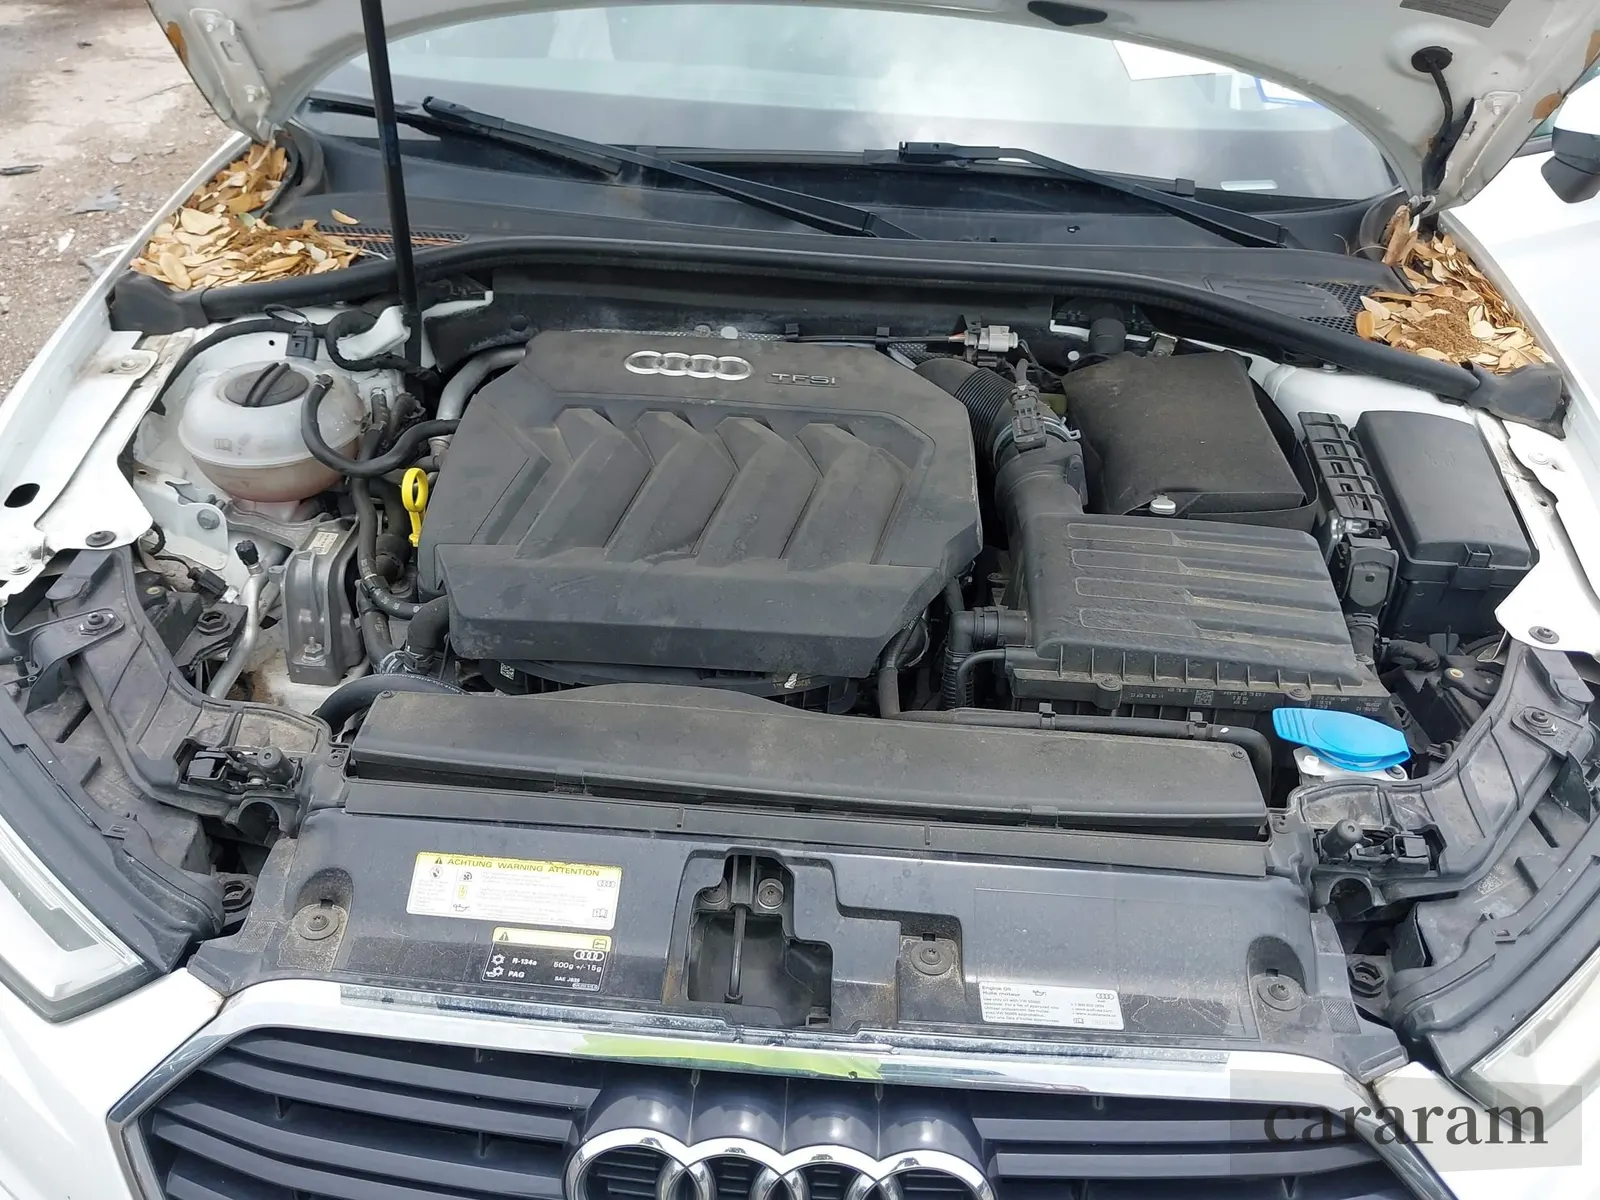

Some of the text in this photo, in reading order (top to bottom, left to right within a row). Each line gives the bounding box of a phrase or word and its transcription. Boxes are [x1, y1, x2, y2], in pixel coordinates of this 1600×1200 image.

[771, 373, 836, 385] TFSI
[447, 858, 600, 877] ACHTUNG WARNING ATTENTION
[512, 957, 537, 966] R-134a
[553, 961, 574, 970] 500g
[508, 970, 525, 978] PAG
